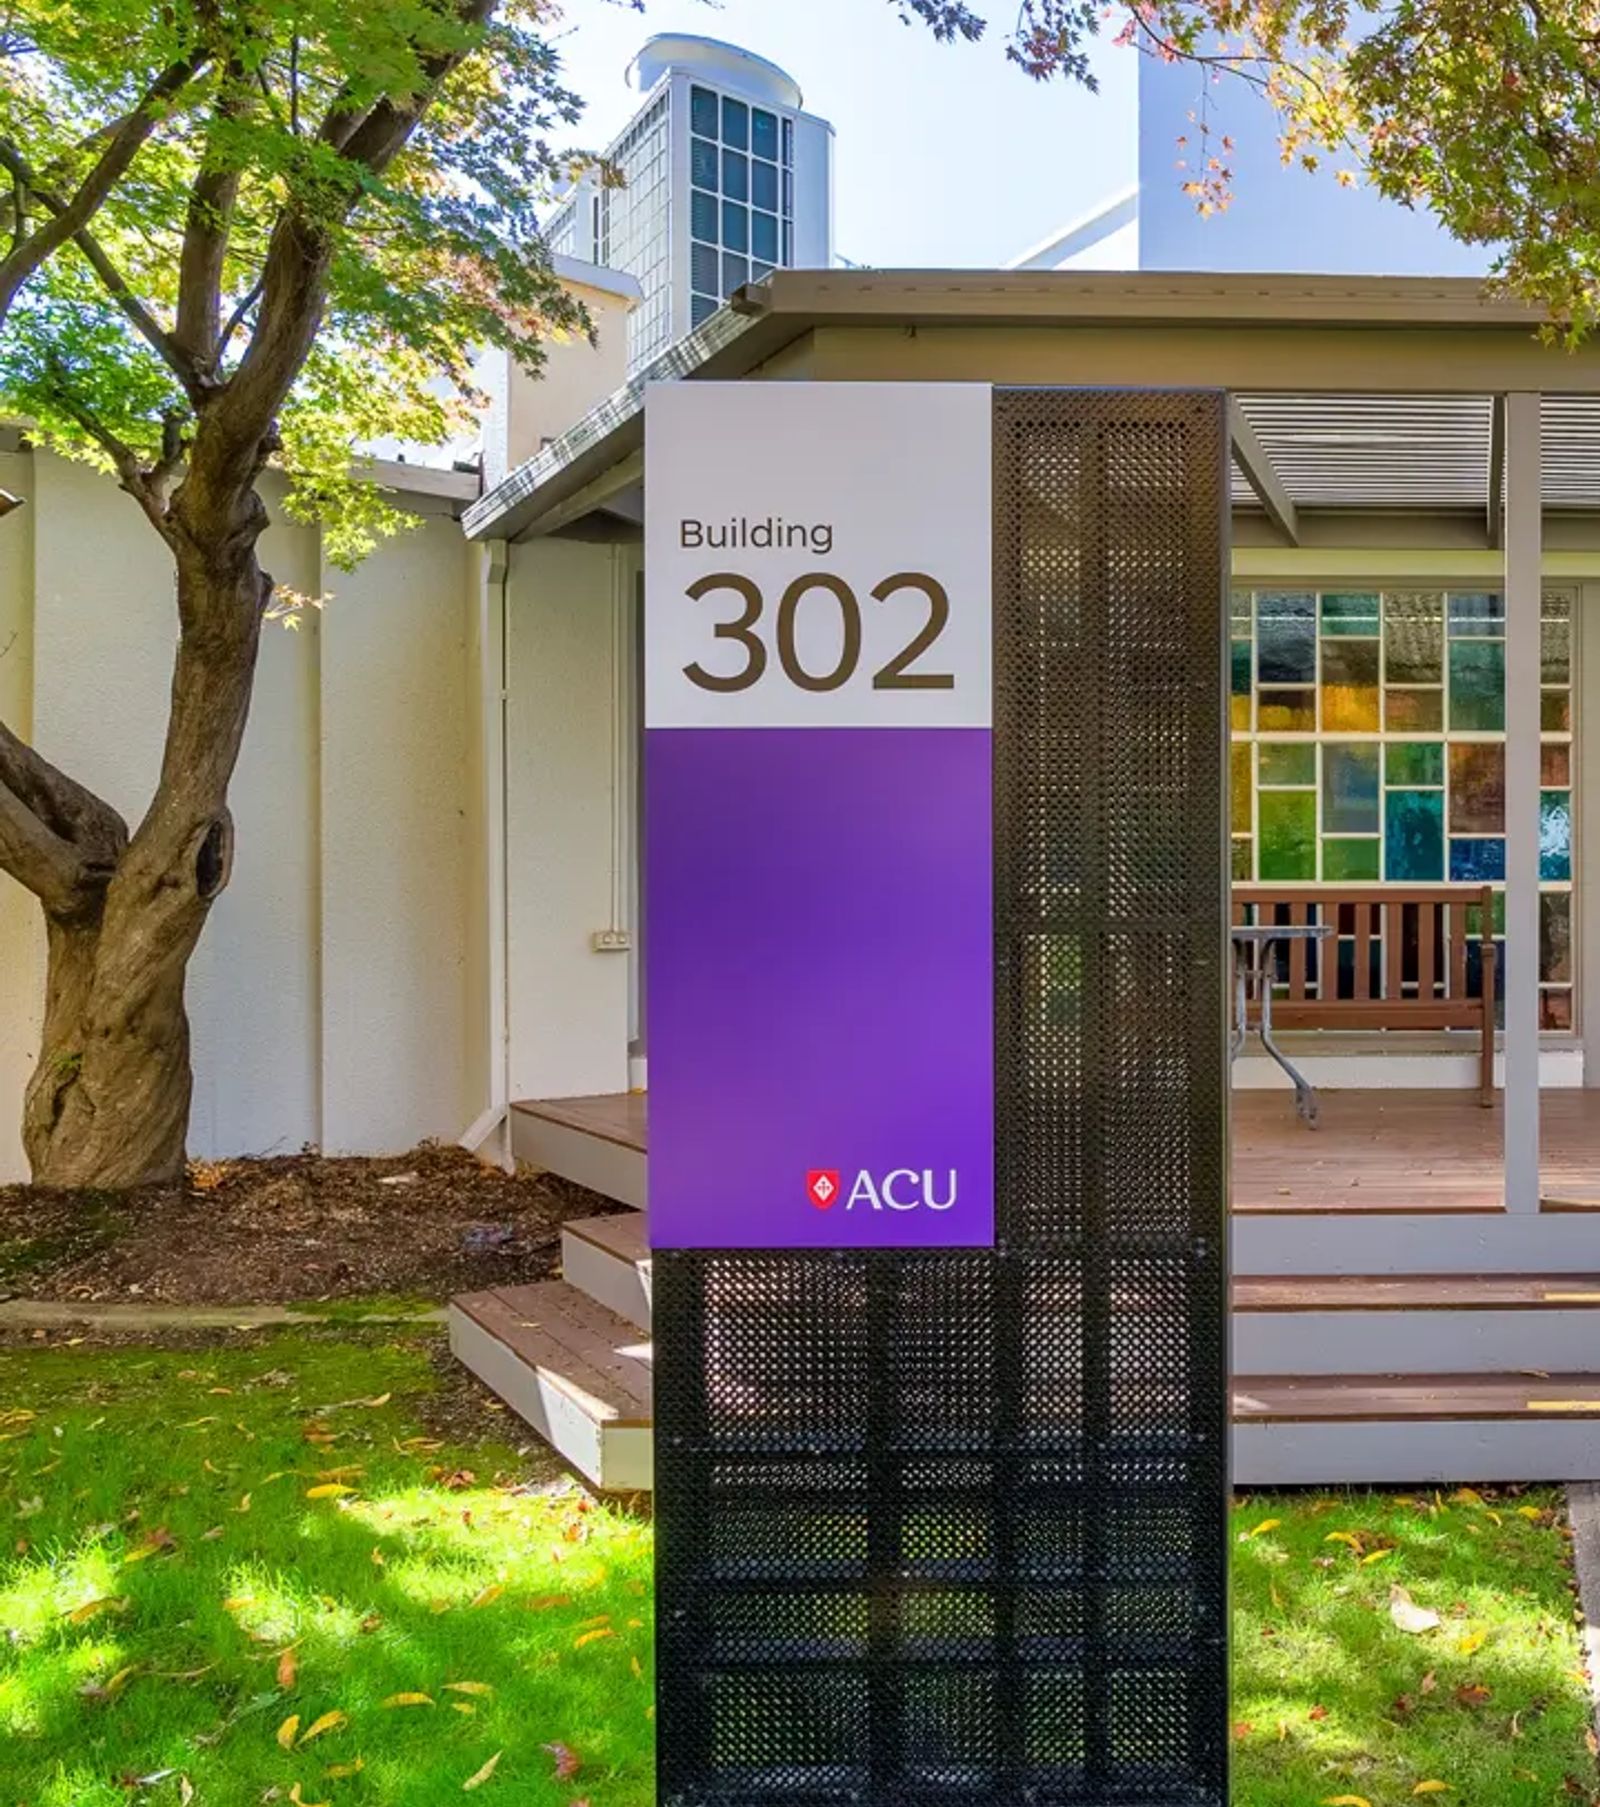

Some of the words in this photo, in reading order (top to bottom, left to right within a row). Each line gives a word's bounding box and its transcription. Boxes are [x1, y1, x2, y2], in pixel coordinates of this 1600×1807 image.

[680, 517, 833, 554] Building
[682, 571, 954, 692] 302
[846, 1168, 957, 1211] ACU
